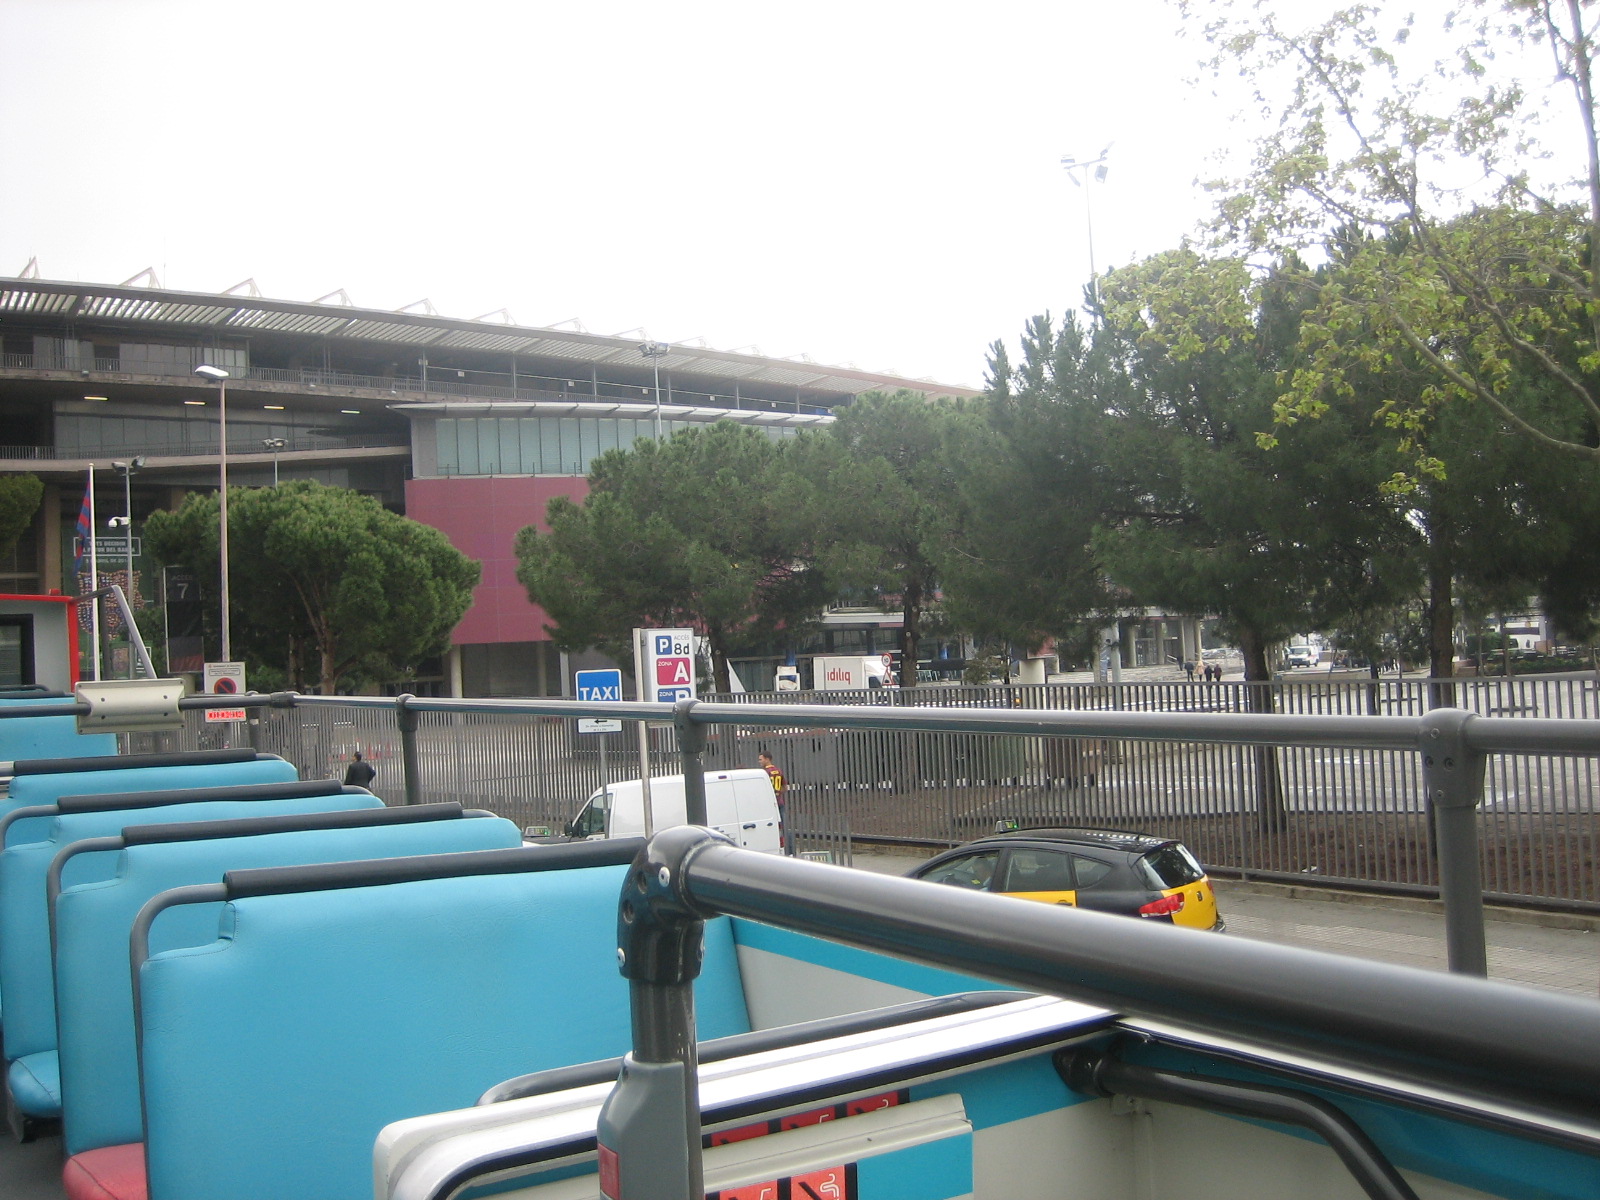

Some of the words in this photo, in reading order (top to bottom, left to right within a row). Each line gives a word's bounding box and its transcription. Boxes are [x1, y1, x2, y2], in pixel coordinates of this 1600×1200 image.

[177, 583, 189, 599] 7
[659, 639, 668, 652] P
[674, 643, 689, 654] 8d
[673, 661, 689, 682] A
[580, 686, 618, 701] TAXI
[811, 855, 827, 863] TAXI
